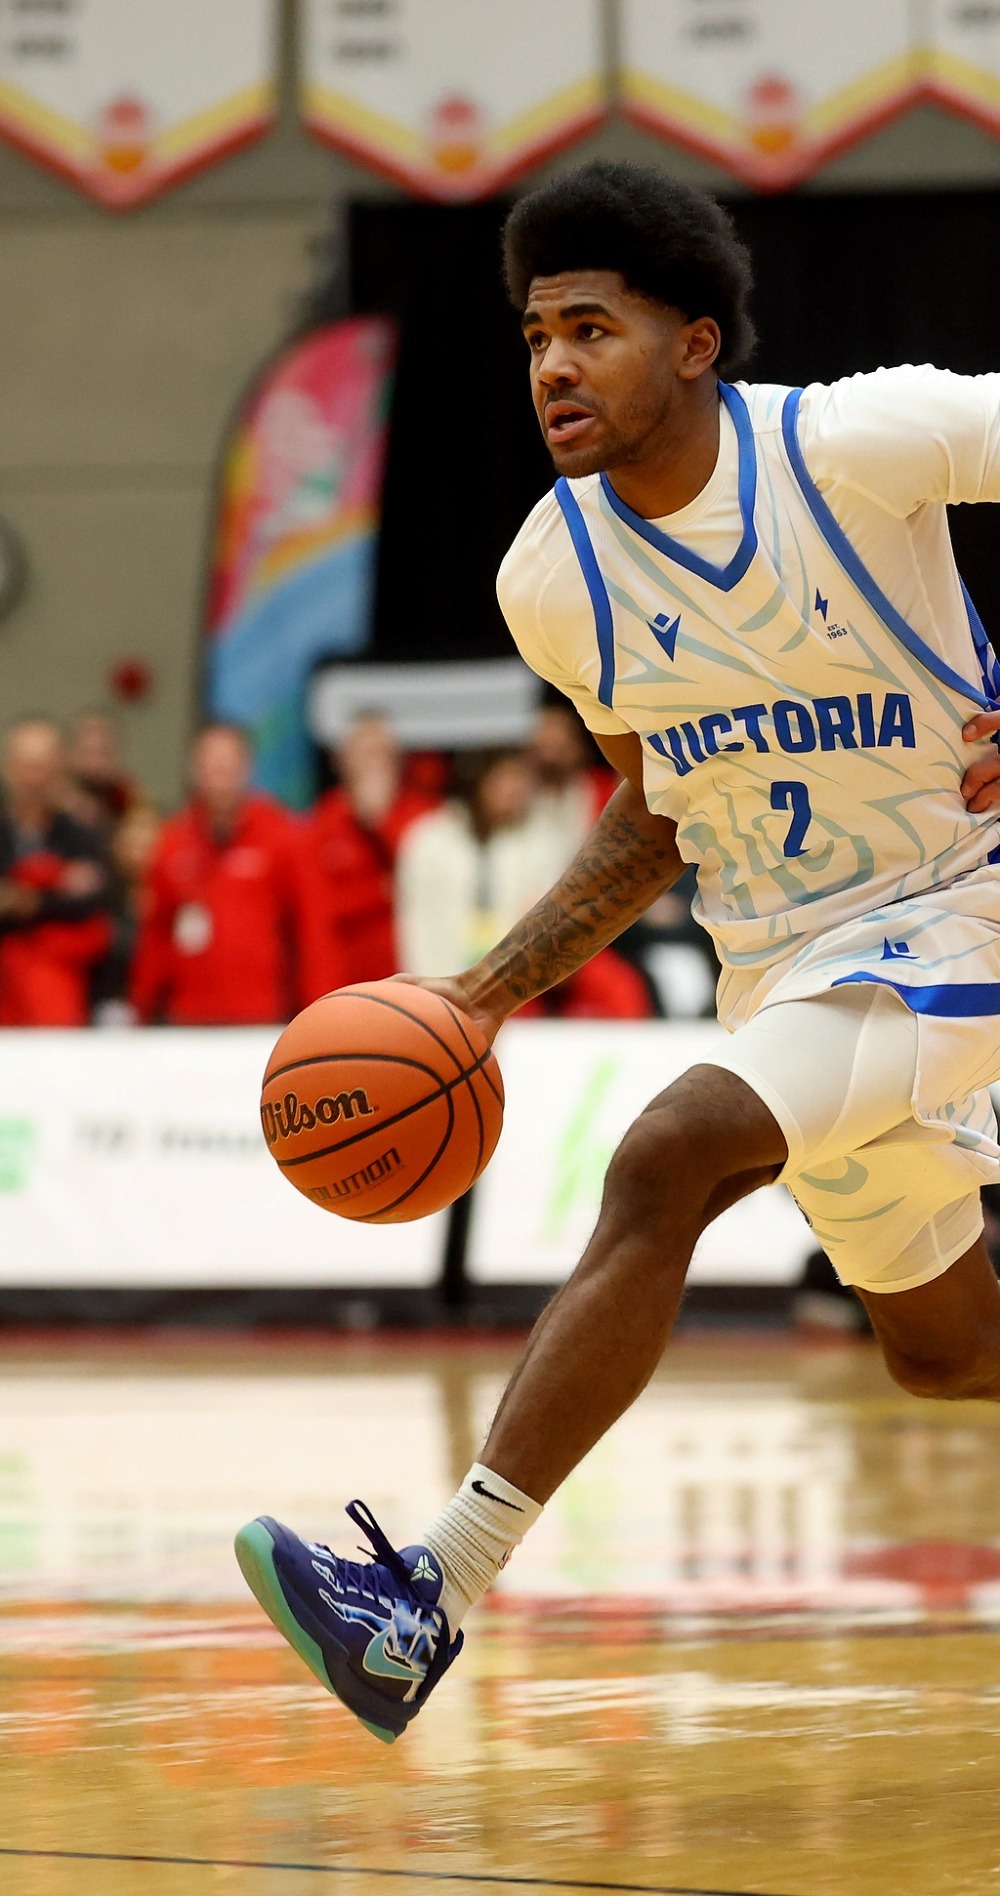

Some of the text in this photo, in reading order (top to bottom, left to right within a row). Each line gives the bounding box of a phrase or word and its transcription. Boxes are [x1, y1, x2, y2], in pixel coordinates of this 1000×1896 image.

[827, 628, 848, 640] 1963
[647, 692, 917, 777] VICTORIA
[770, 780, 812, 858] 2
[302, 1147, 401, 1201] OLUTION
